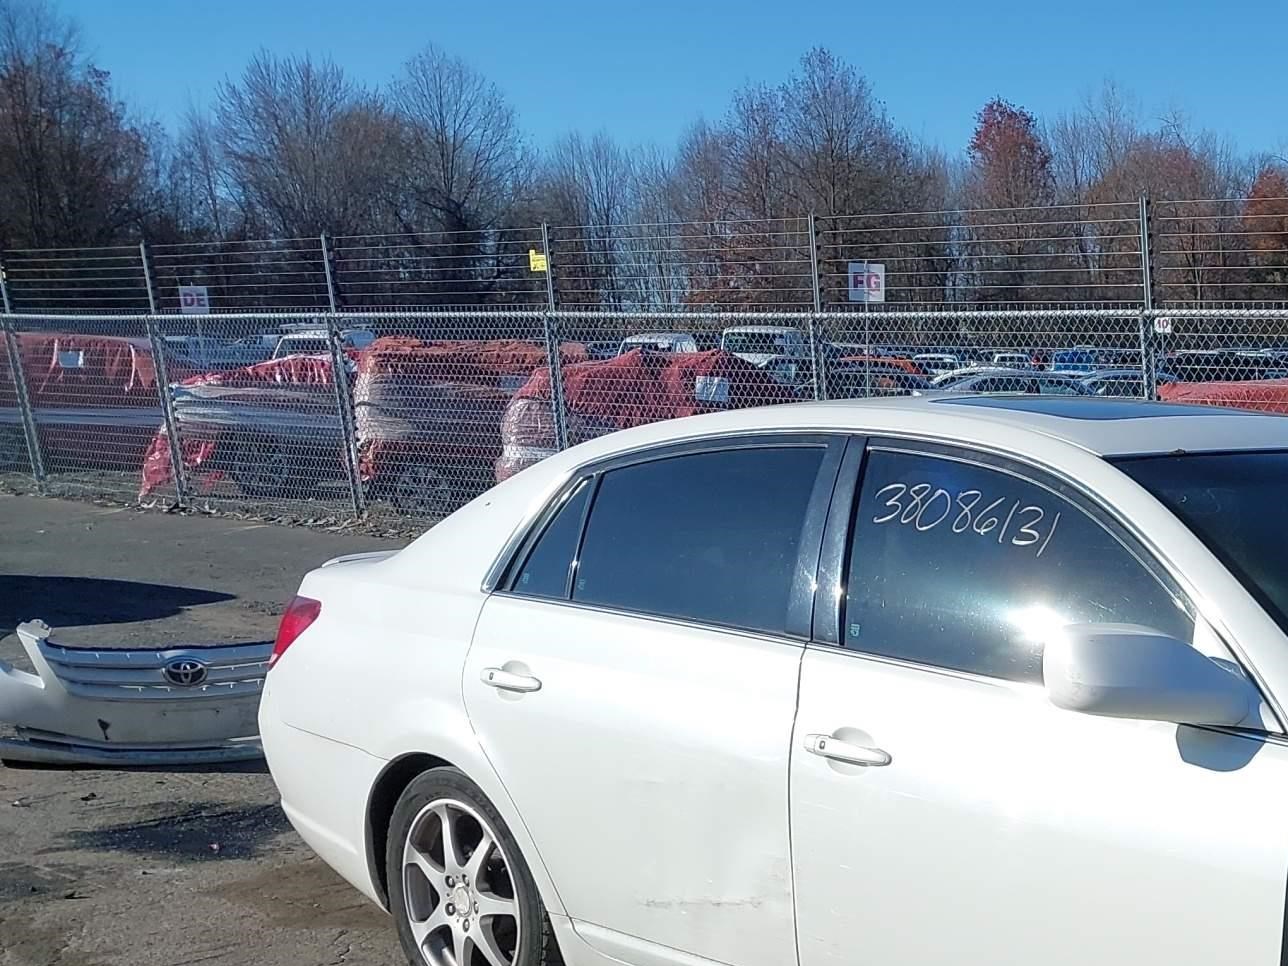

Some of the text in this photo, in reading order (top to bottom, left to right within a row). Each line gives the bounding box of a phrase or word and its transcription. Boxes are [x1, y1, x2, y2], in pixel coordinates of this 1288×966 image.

[852, 271, 881, 292] FG
[182, 292, 207, 308] DE
[872, 482, 1062, 558] 38086131
